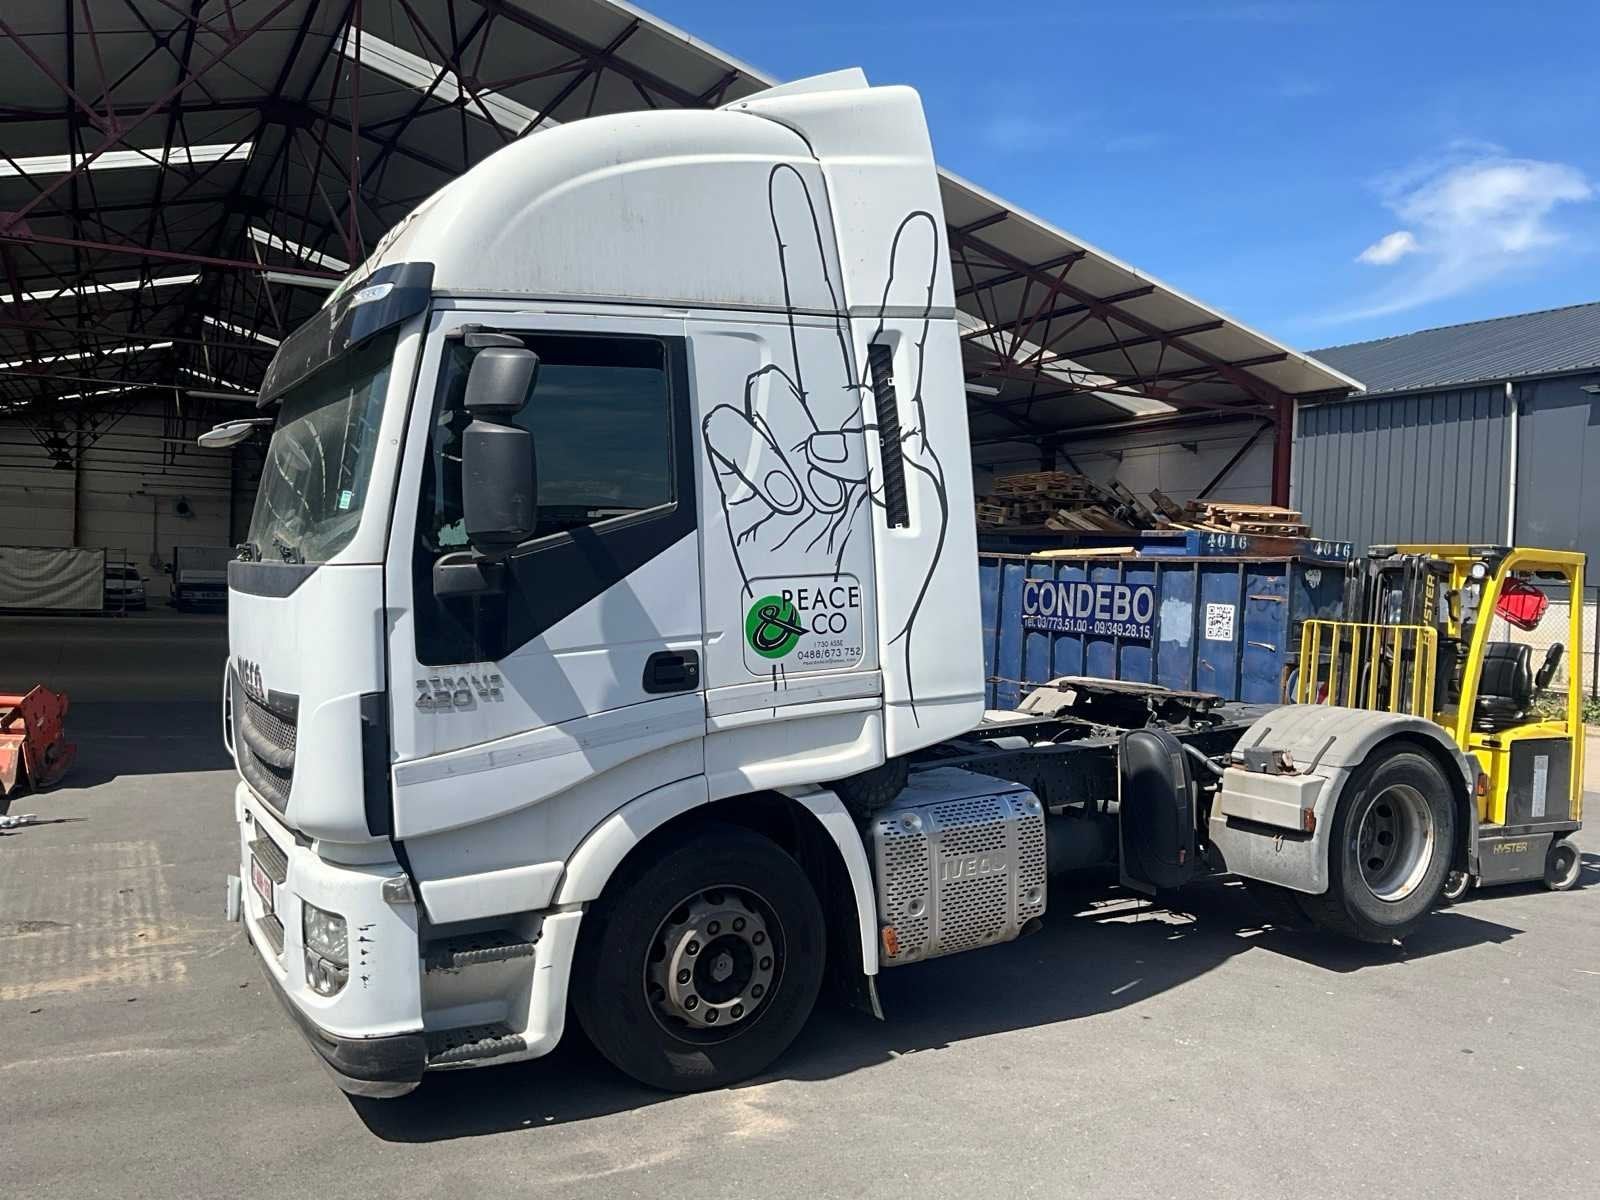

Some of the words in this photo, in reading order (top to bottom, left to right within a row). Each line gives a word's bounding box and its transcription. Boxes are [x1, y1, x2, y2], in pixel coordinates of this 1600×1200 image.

[1207, 533, 1248, 550] 4016
[1313, 542, 1351, 557] 4016
[782, 586, 859, 611] PEACE
[1023, 582, 1154, 624] CONDEBO
[812, 612, 847, 635] CO
[1094, 621, 1150, 639] 09/349.28.15
[797, 648, 842, 660] 0488/673
[844, 646, 861, 656] 752
[1493, 842, 1528, 855] HYSTER
[942, 853, 1006, 881] IVECO
